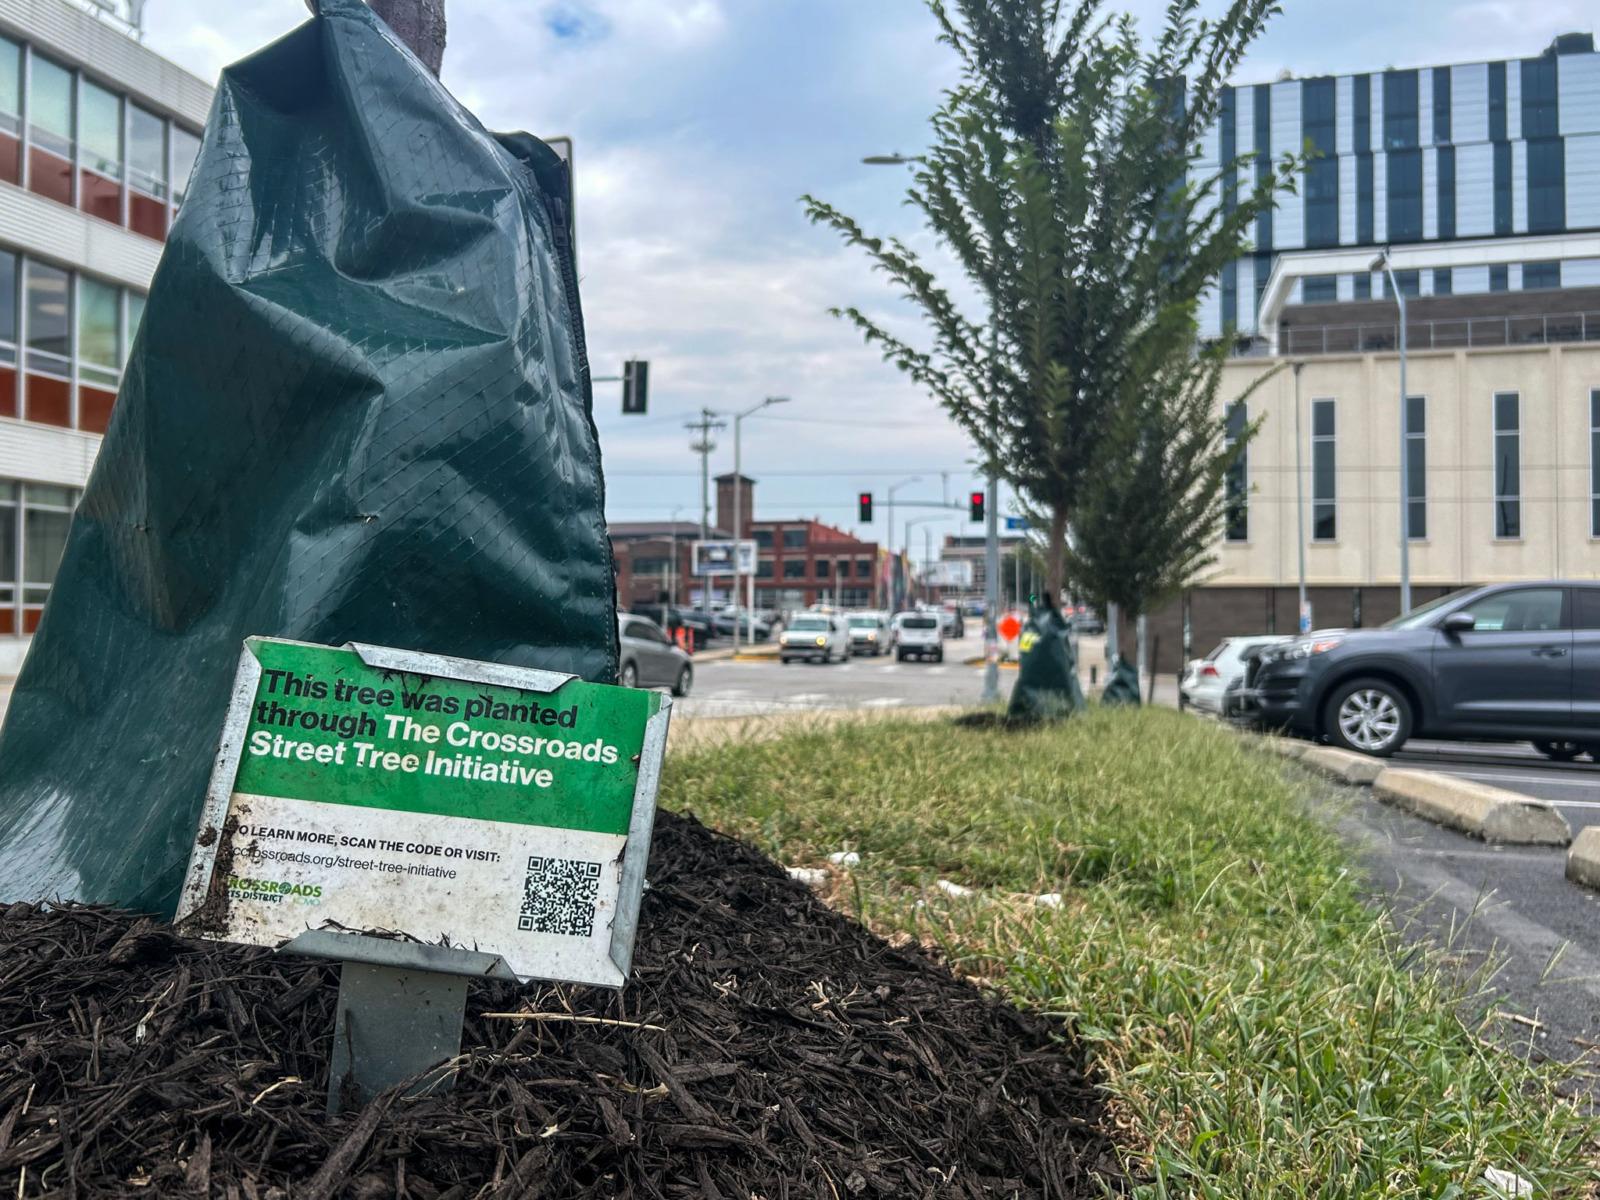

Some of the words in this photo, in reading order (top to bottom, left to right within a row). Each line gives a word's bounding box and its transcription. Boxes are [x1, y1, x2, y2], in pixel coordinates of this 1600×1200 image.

[265, 669, 328, 699] This
[335, 679, 395, 707] tree
[401, 691, 460, 714] was
[463, 695, 578, 728] planted
[257, 701, 377, 739] through
[384, 714, 440, 744] The
[446, 721, 618, 764] Crossroads
[249, 730, 347, 765] Street
[353, 742, 420, 772] Tree
[424, 750, 553, 788] Initiative
[233, 824, 249, 836] O
[251, 826, 295, 840] LEARN
[296, 831, 338, 847] MORE,
[340, 836, 377, 849] SCAN
[379, 840, 404, 852] THE
[406, 843, 442, 856] CODE
[444, 847, 463, 858] OR
[465, 849, 501, 863] VISIT:
[226, 876, 323, 898] ROSSROADS
[243, 891, 284, 904] DISTRICT
